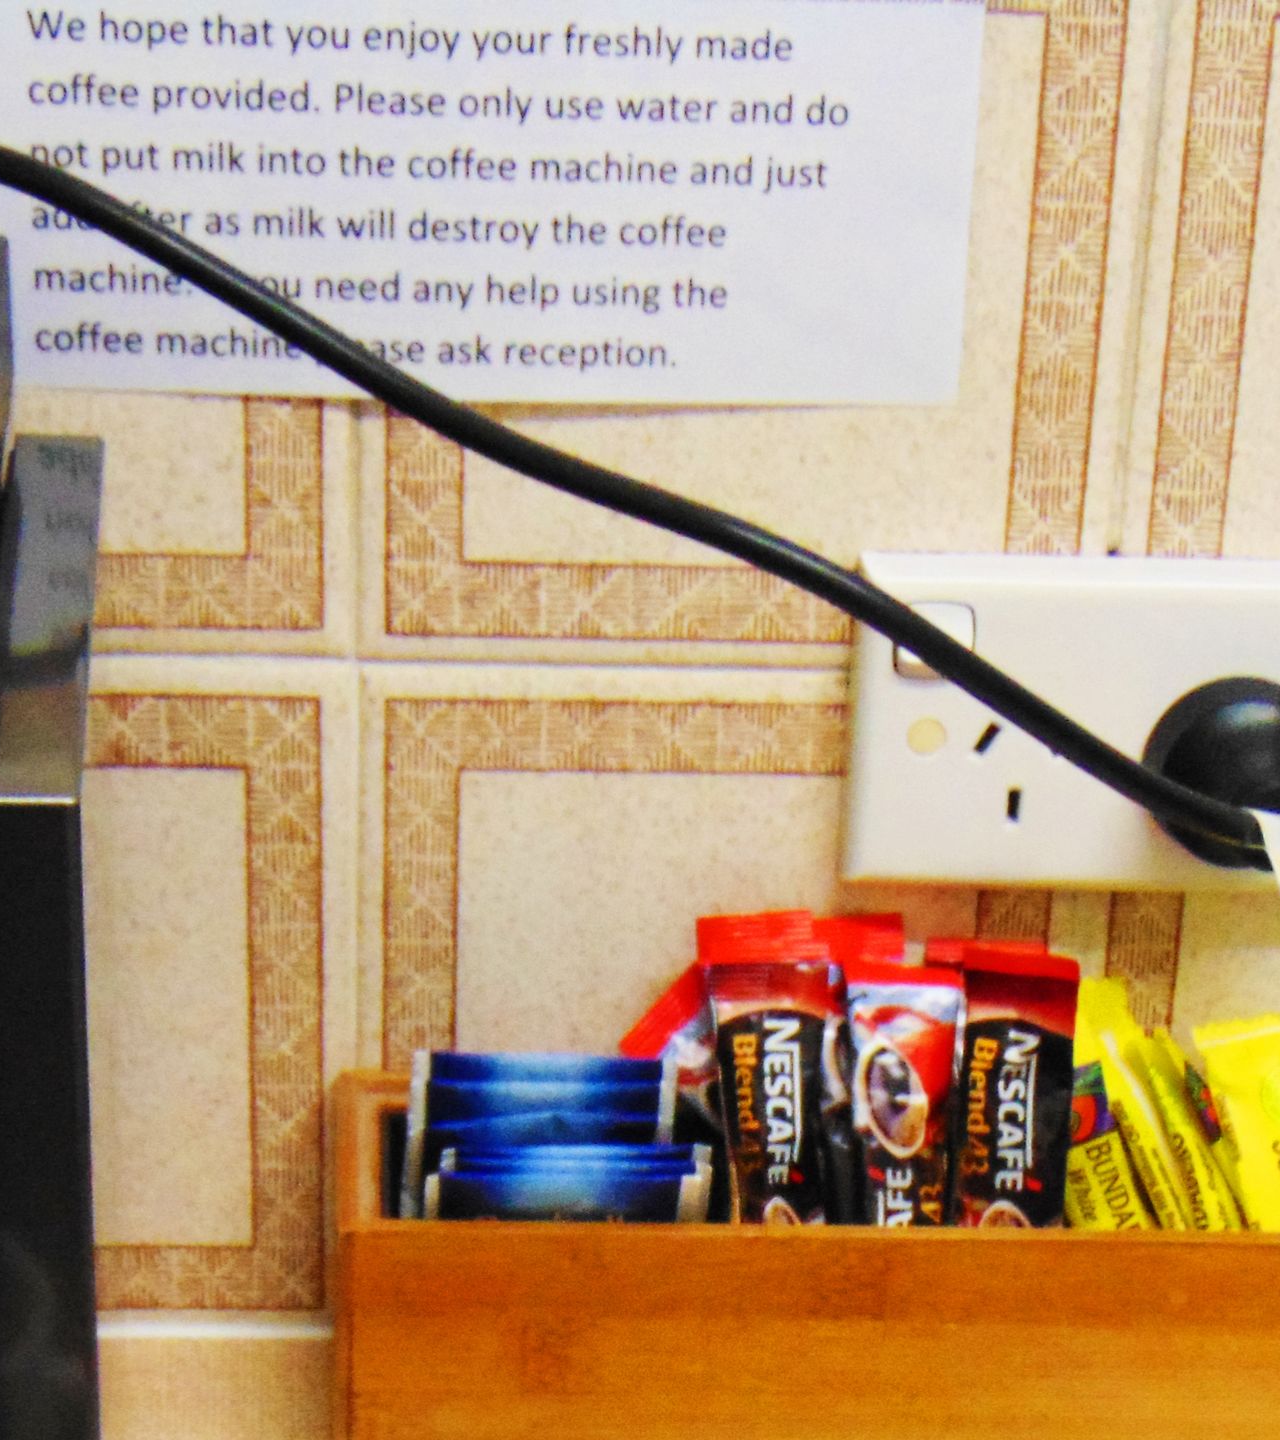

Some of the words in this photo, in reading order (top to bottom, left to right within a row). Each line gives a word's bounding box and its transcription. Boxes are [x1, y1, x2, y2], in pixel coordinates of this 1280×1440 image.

[27, 9, 85, 41] We
[100, 10, 188, 50] hope
[202, 14, 273, 47] that
[287, 25, 350, 55] you
[364, 21, 460, 60] enjoy
[472, 30, 552, 61] your
[564, 23, 683, 65] freshly
[696, 29, 793, 62] made
[28, 73, 139, 107] coffee
[152, 79, 321, 114] provided.
[334, 82, 446, 117] Please
[459, 86, 532, 126] only
[546, 97, 604, 121] use
[616, 95, 718, 124] water
[730, 94, 793, 125] and
[806, 94, 850, 127] do
[31, 142, 89, 171] not
[102, 144, 159, 175] put
[173, 142, 246, 174] milk
[257, 144, 326, 176] into
[339, 146, 395, 178] the
[408, 146, 517, 181] coffee
[530, 152, 677, 185] machine
[690, 155, 753, 187] and
[762, 156, 828, 193] just
[205, 211, 240, 237] as
[254, 206, 325, 239] milk
[336, 207, 395, 241] will
[408, 210, 539, 251] destroy
[551, 213, 607, 245] the
[619, 215, 727, 247] coffee
[34, 262, 193, 296] machine.
[315, 269, 401, 301] need
[413, 279, 474, 311] any
[486, 273, 559, 312] help
[572, 281, 662, 315] using
[672, 277, 728, 309] the
[35, 320, 143, 353] coffee
[437, 334, 492, 365] ask
[504, 337, 677, 373] reception.
[1085, 1139, 1142, 1231] BUNDA
